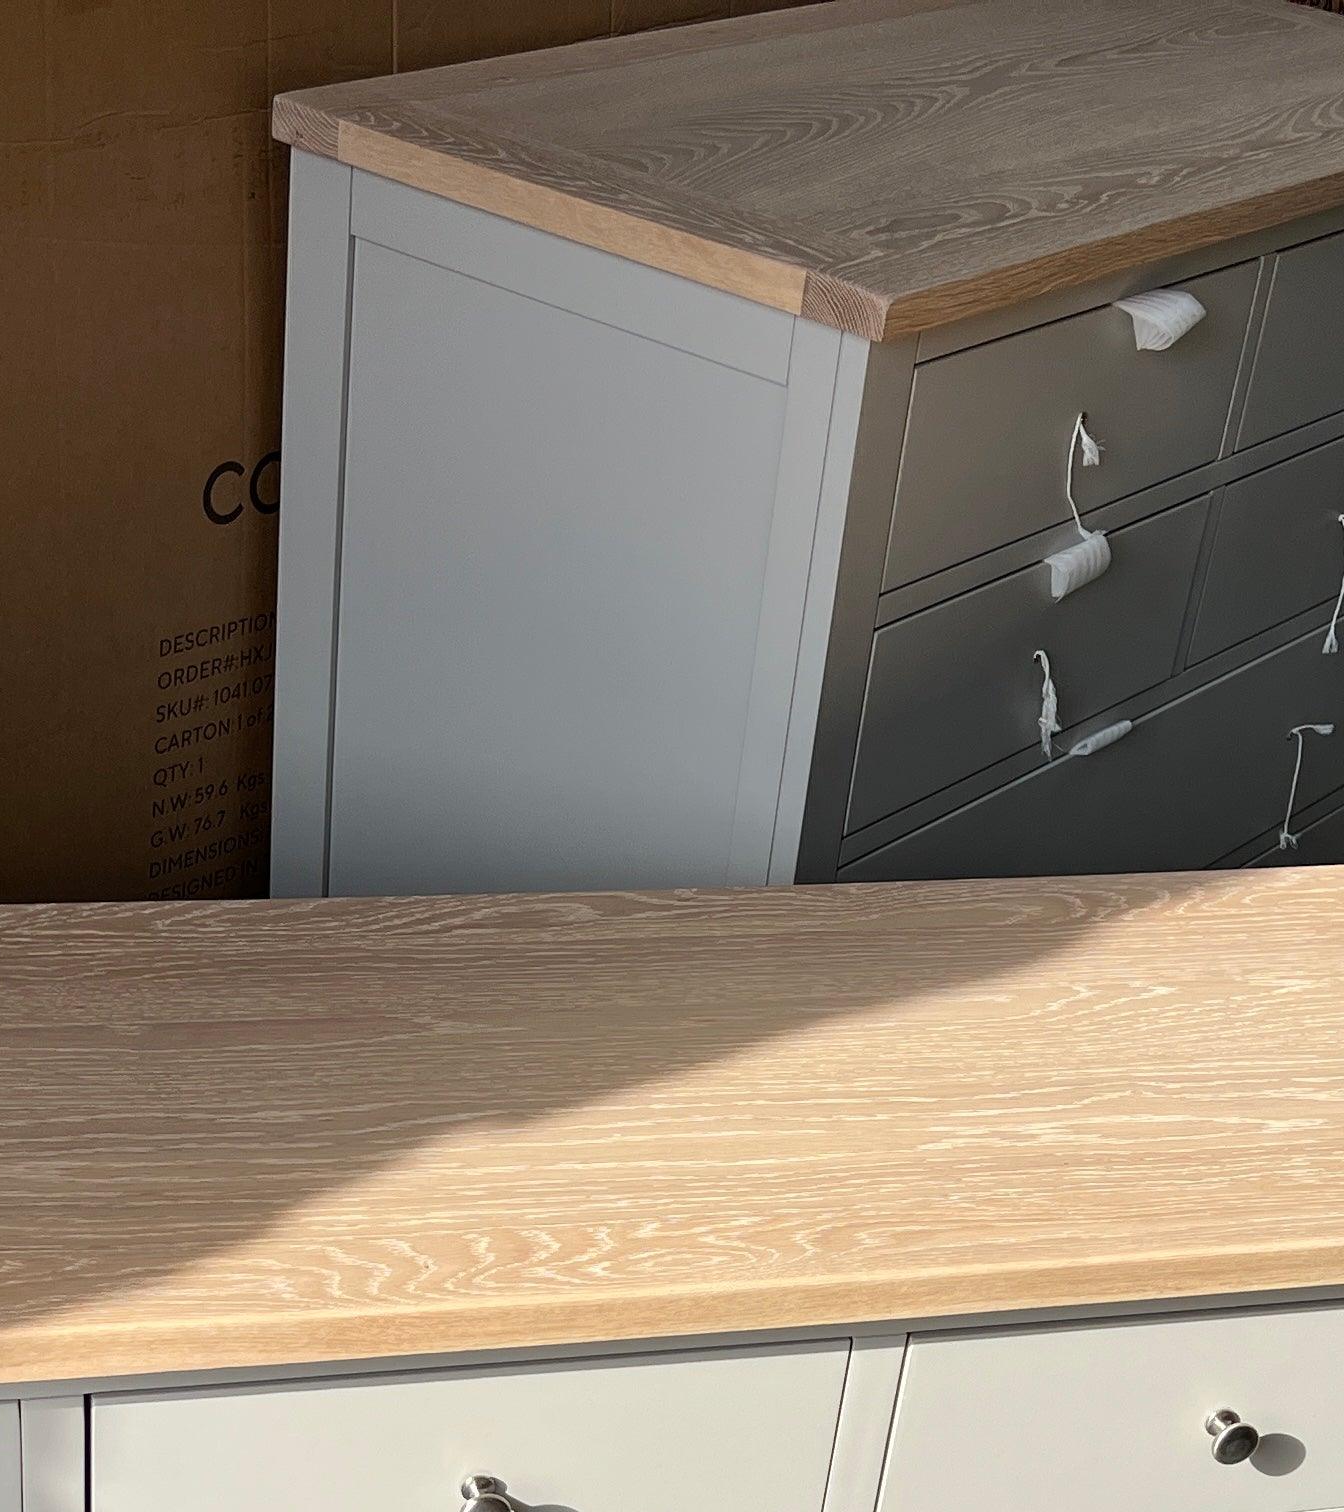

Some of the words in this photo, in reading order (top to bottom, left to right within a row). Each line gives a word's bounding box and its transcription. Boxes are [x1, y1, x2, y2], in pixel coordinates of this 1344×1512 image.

[156, 695, 209, 722] SKU#:
[247, 706, 264, 727] of
[153, 761, 193, 787] QTY:
[237, 773, 265, 791] Kgs
